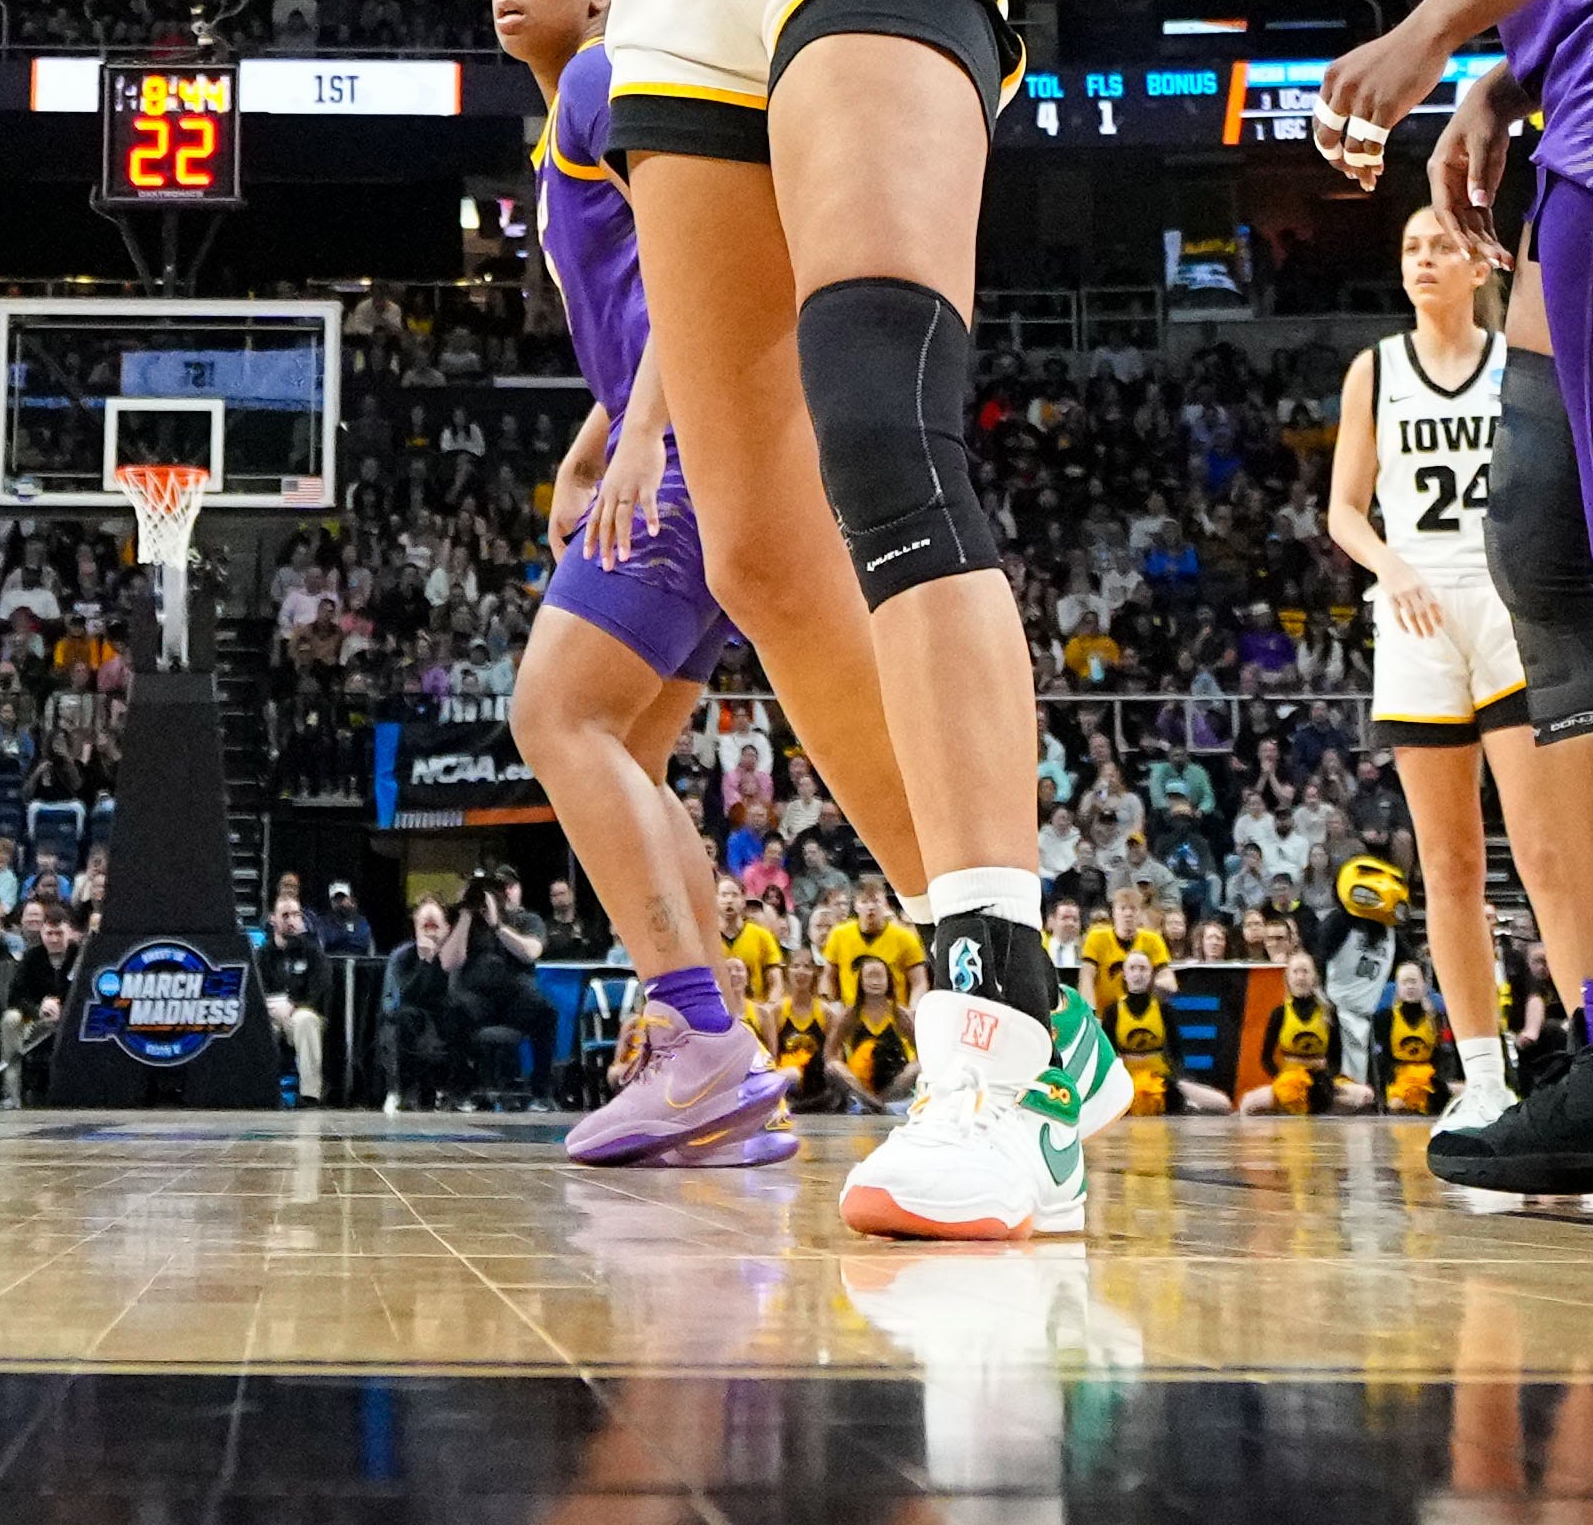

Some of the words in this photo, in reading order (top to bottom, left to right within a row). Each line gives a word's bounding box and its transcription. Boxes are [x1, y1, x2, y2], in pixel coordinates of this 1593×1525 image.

[313, 73, 361, 106] 1ST
[1025, 72, 1065, 99] TOL
[1085, 72, 1124, 98] FLS
[1146, 71, 1218, 97] BONUS
[1036, 100, 1059, 137] 4
[1097, 99, 1118, 135] 1
[1273, 117, 1308, 140] USC
[130, 116, 217, 189] 22
[1414, 462, 1493, 532] 24
[410, 753, 535, 786] NCAA.co
[120, 971, 204, 1000] MARCH
[128, 998, 241, 1026] MADNESS
